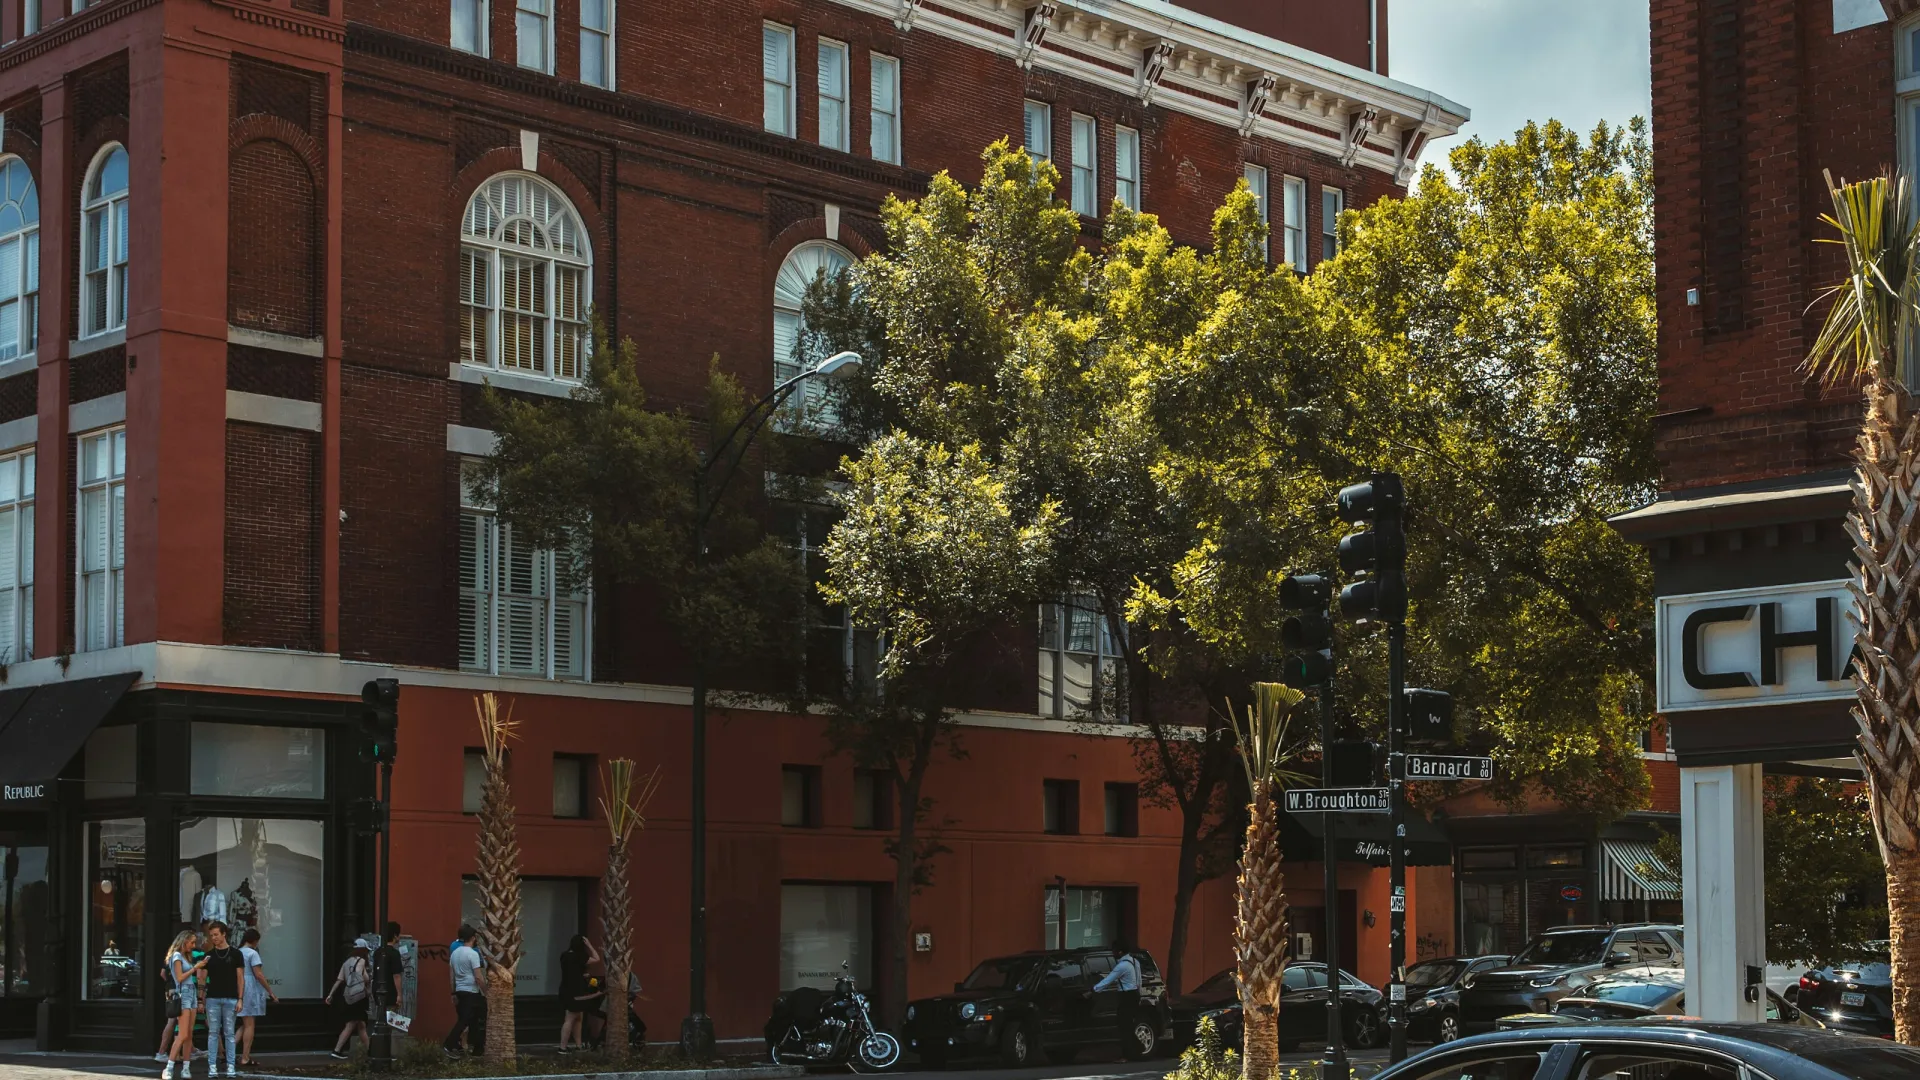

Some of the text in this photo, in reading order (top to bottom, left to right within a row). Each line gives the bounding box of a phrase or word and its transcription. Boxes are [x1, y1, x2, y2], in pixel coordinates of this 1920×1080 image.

[1682, 597, 1863, 690] CH
[1413, 758, 1489, 776] Barnard ST
[1480, 769, 1489, 778] 00
[1378, 789, 1387, 799] ST
[1378, 799, 1387, 808] 00
[1355, 841, 1386, 860] Telfair
